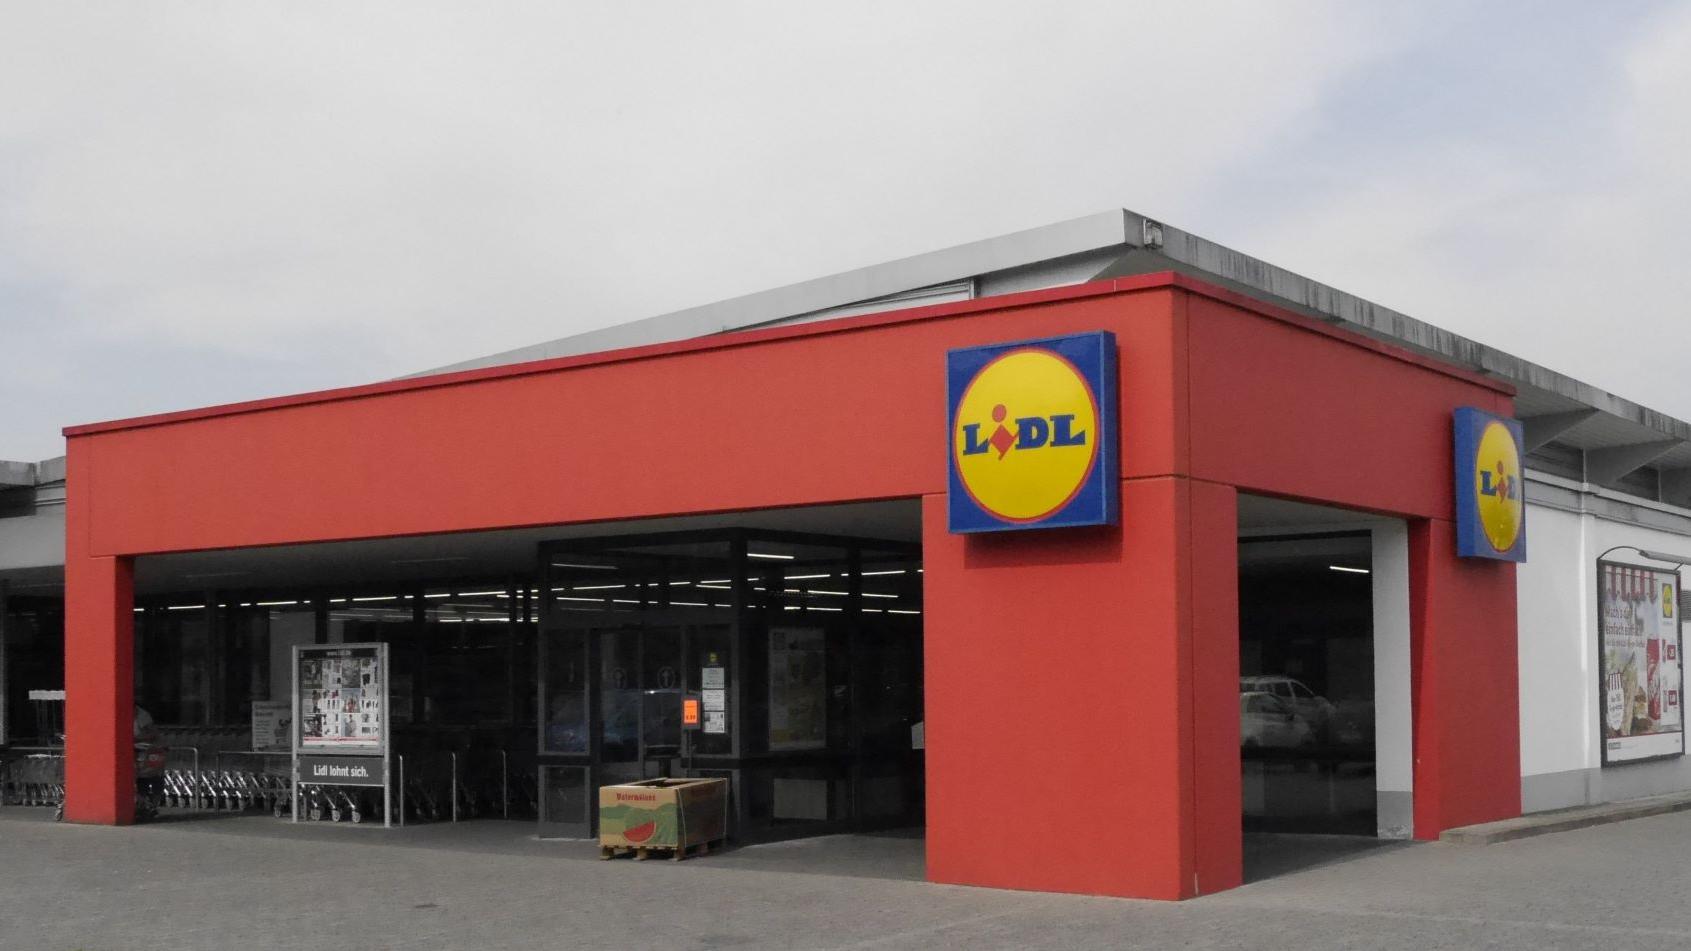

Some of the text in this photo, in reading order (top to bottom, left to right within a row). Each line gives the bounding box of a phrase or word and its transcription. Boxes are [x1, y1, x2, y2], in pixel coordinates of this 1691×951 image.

[313, 764, 369, 777] Lidl lohnt sich.
